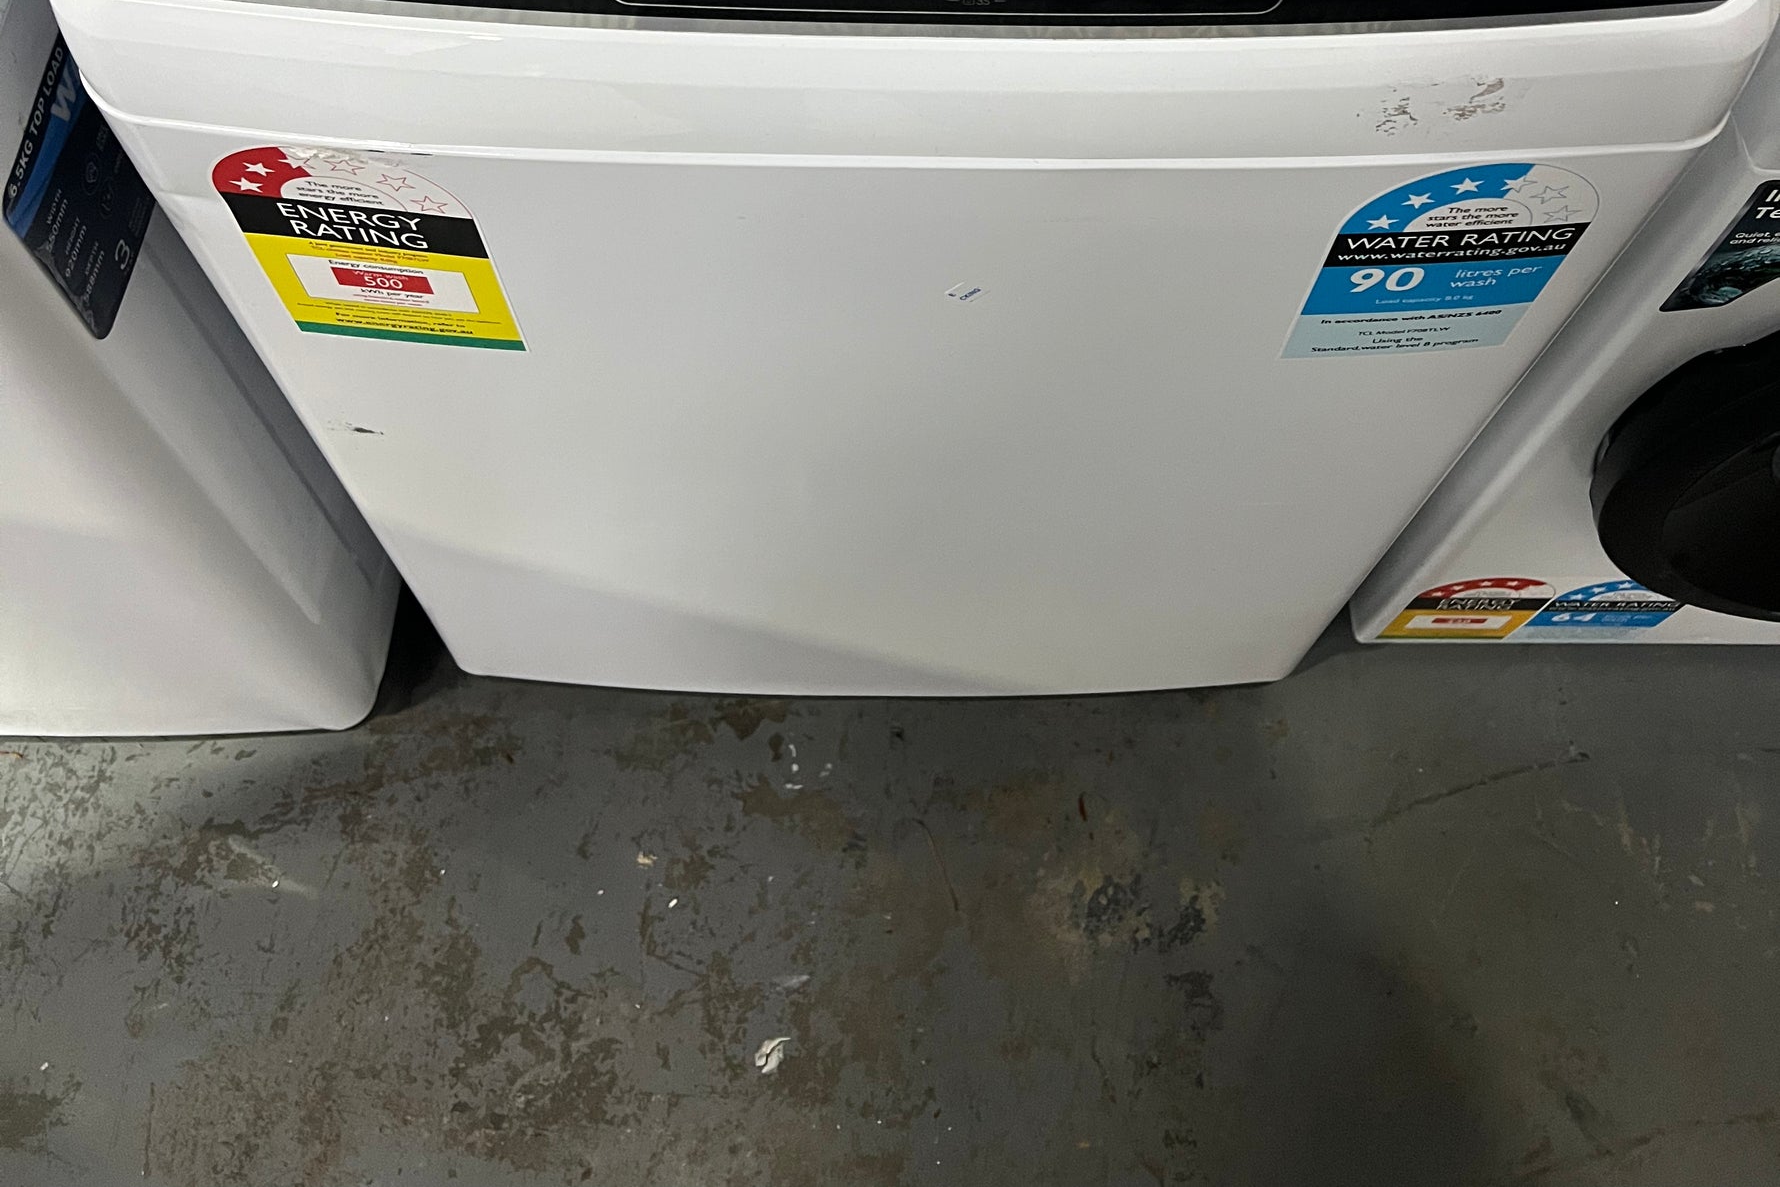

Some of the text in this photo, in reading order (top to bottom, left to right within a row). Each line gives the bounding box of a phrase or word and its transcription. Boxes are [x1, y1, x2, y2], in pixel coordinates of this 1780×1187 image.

[9, 140, 34, 199] 6.5KG
[28, 97, 45, 136] TOP
[43, 46, 64, 97] LOAD
[296, 186, 324, 194] stars
[348, 192, 380, 200] more
[304, 180, 362, 192] The more
[298, 192, 384, 206] energy efficient
[276, 202, 422, 231] ENERGY
[1447, 205, 1508, 214] The more
[1460, 213, 1479, 221] the
[1483, 211, 1520, 219] more
[1464, 218, 1514, 227] efficient
[289, 219, 429, 249] RATING
[1347, 227, 1576, 250] WATER RATING
[1337, 243, 1567, 261] www.waterrating.gov.au
[328, 259, 424, 275] Energy consumption
[352, 270, 383, 278] Warm
[1455, 266, 1543, 279] litres per
[363, 276, 403, 290] 500
[1350, 267, 1425, 293] 90
[1449, 277, 1497, 288] wash
[1334, 316, 1399, 324] accordance
[1395, 341, 1421, 349] level
[1432, 338, 1479, 347] program
